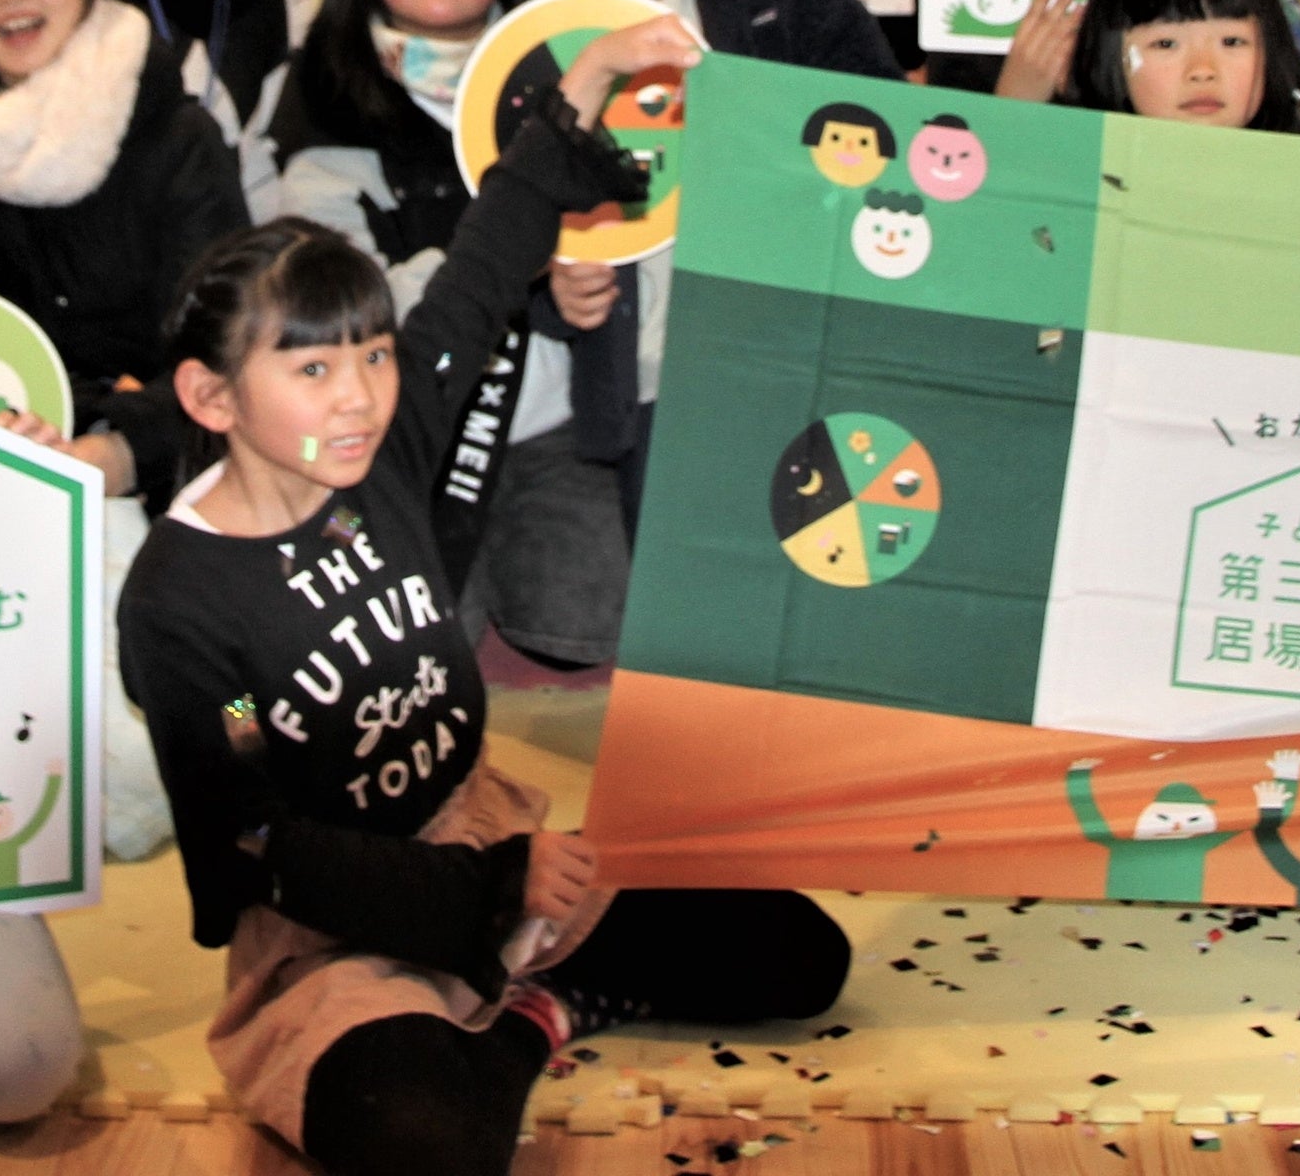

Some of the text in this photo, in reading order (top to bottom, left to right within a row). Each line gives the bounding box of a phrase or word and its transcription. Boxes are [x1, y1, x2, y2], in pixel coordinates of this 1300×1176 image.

[287, 532, 385, 609] THE
[269, 575, 454, 743] FUTUR
[347, 707, 468, 809] TODA
